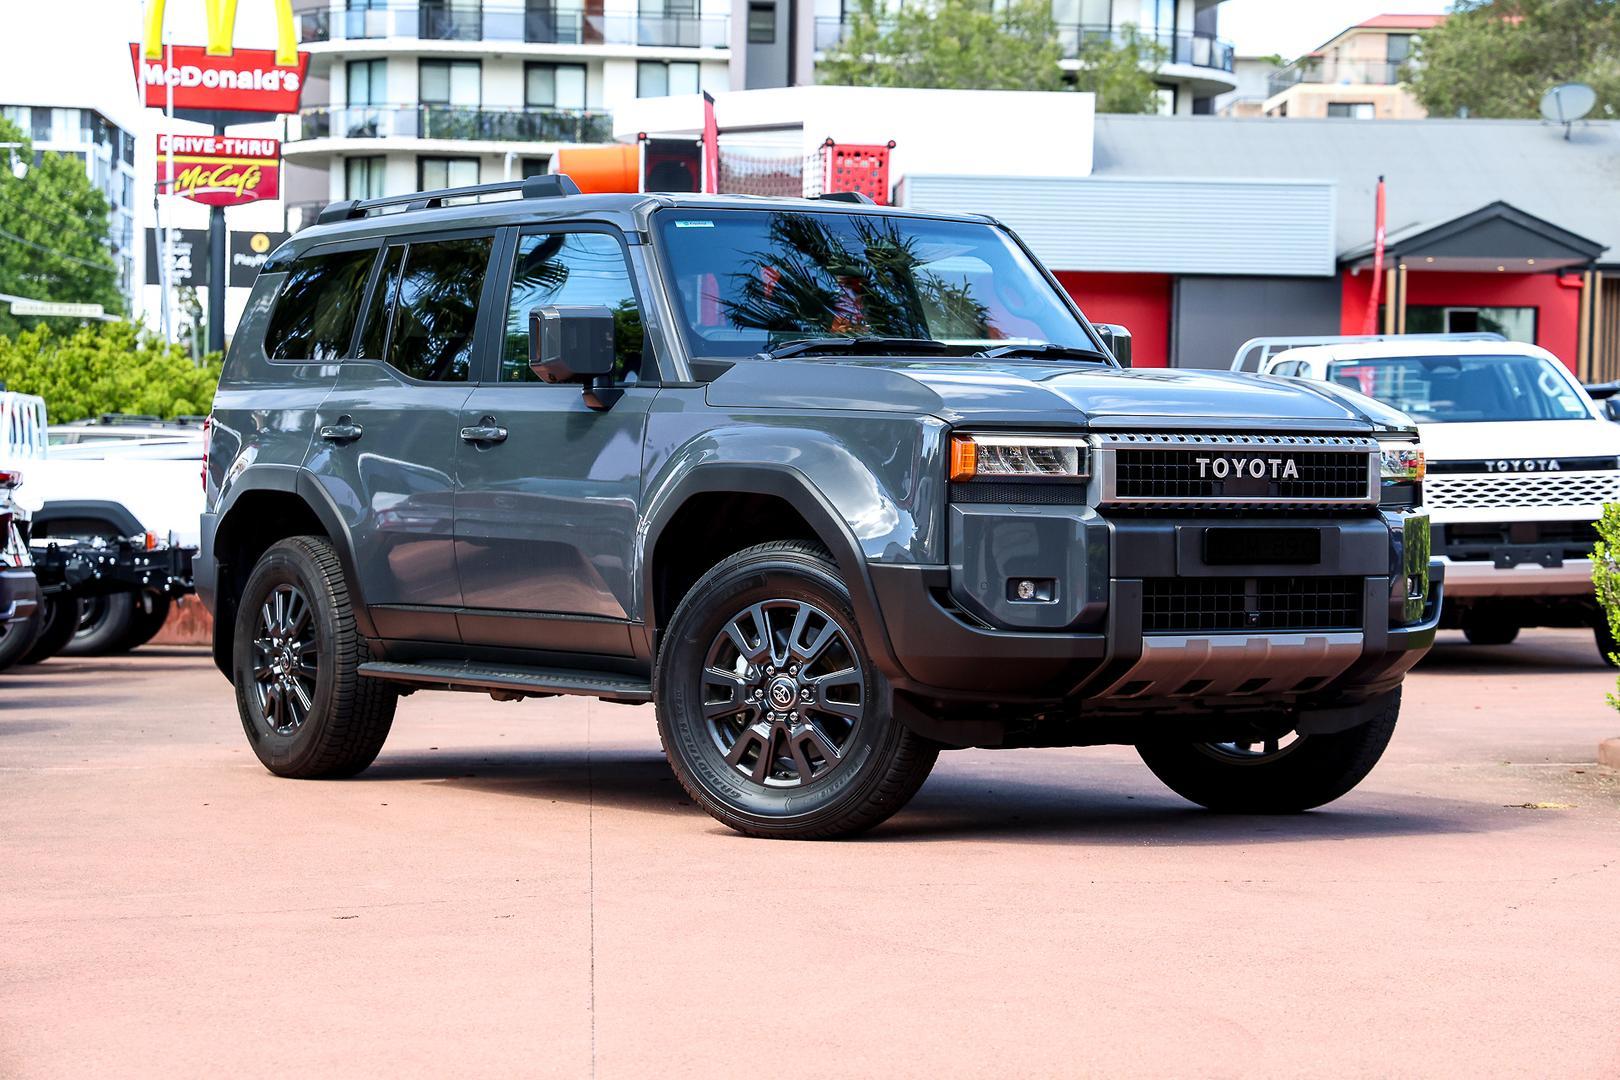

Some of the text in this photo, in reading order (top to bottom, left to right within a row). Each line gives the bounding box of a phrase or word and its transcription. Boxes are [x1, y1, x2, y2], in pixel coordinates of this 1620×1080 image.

[144, 64, 300, 92] McDonald's
[160, 136, 275, 156] DRIVE-THRU
[1196, 457, 1299, 479] TOYOTA
[1484, 459, 1560, 473] TOYOTA
